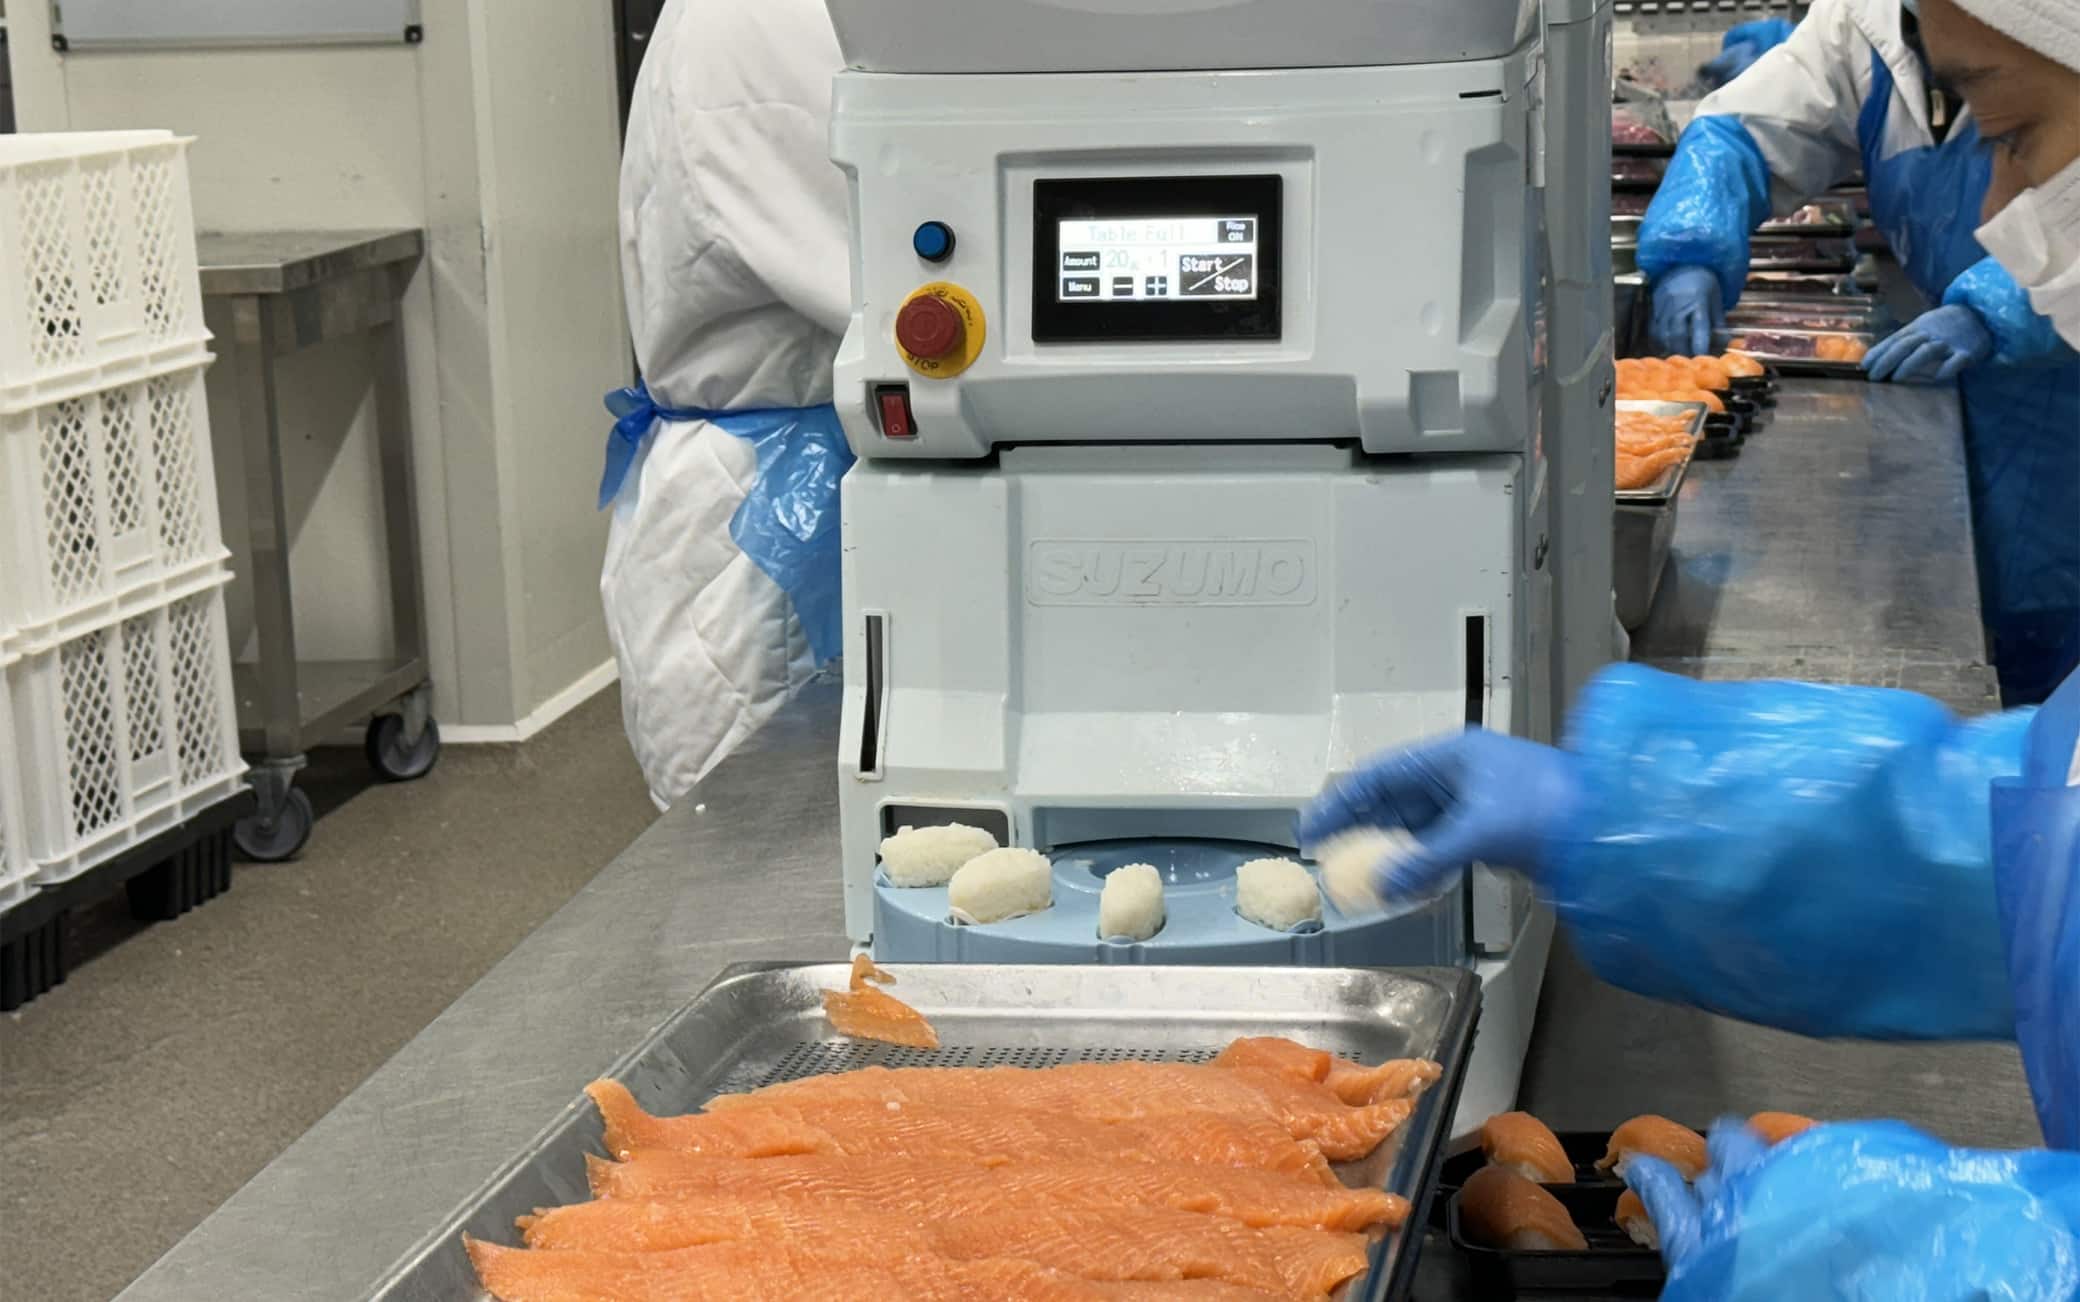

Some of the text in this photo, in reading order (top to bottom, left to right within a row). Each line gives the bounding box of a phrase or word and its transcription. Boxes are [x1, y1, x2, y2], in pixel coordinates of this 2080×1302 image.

[1088, 223, 1185, 241] Table Full
[1064, 255, 1097, 267] Amount
[1182, 256, 1223, 273] Start
[1068, 281, 1092, 292] Menu
[1214, 275, 1249, 293] Stop
[1037, 548, 1306, 597] SUZUMO
